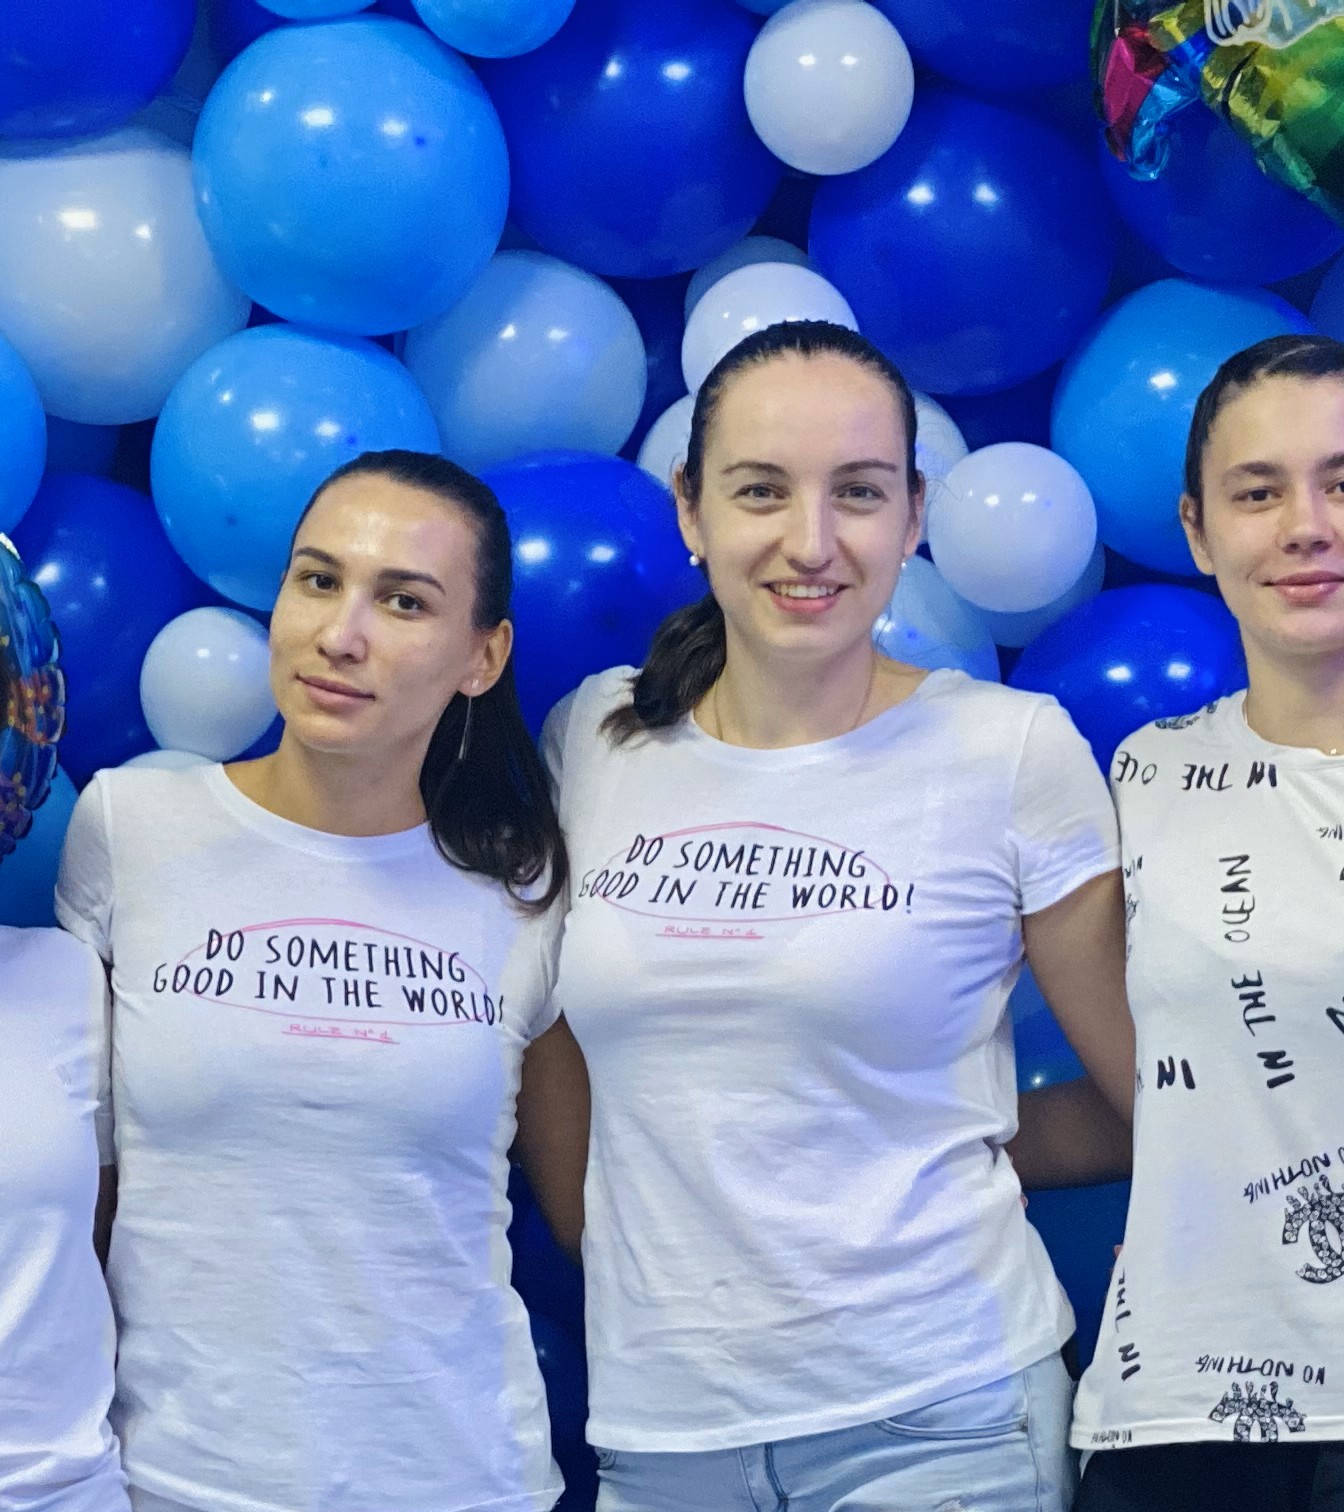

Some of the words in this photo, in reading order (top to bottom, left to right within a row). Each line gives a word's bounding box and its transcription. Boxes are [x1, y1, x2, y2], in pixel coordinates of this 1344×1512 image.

[1115, 751, 1157, 784] OCE
[1181, 763, 1233, 791] THE
[1246, 760, 1277, 789] IN
[625, 834, 664, 866] DO
[673, 841, 866, 878] SOMETHING
[578, 869, 640, 899] GOOD
[648, 875, 697, 905] IN
[715, 881, 771, 910] THE
[792, 883, 915, 914] WORLD!
[1218, 854, 1256, 943] OCEAN
[206, 928, 245, 961] DO
[265, 935, 465, 982] SOMETHING
[153, 963, 234, 996] GOOD
[255, 971, 298, 1001] IN
[322, 977, 382, 1008] THE
[1231, 969, 1276, 1037] THE
[1157, 1055, 1196, 1090] IN
[1257, 1050, 1295, 1089] IN
[1244, 1152, 1331, 1204] NOTHING
[1195, 1354, 1294, 1377] NOTHING
